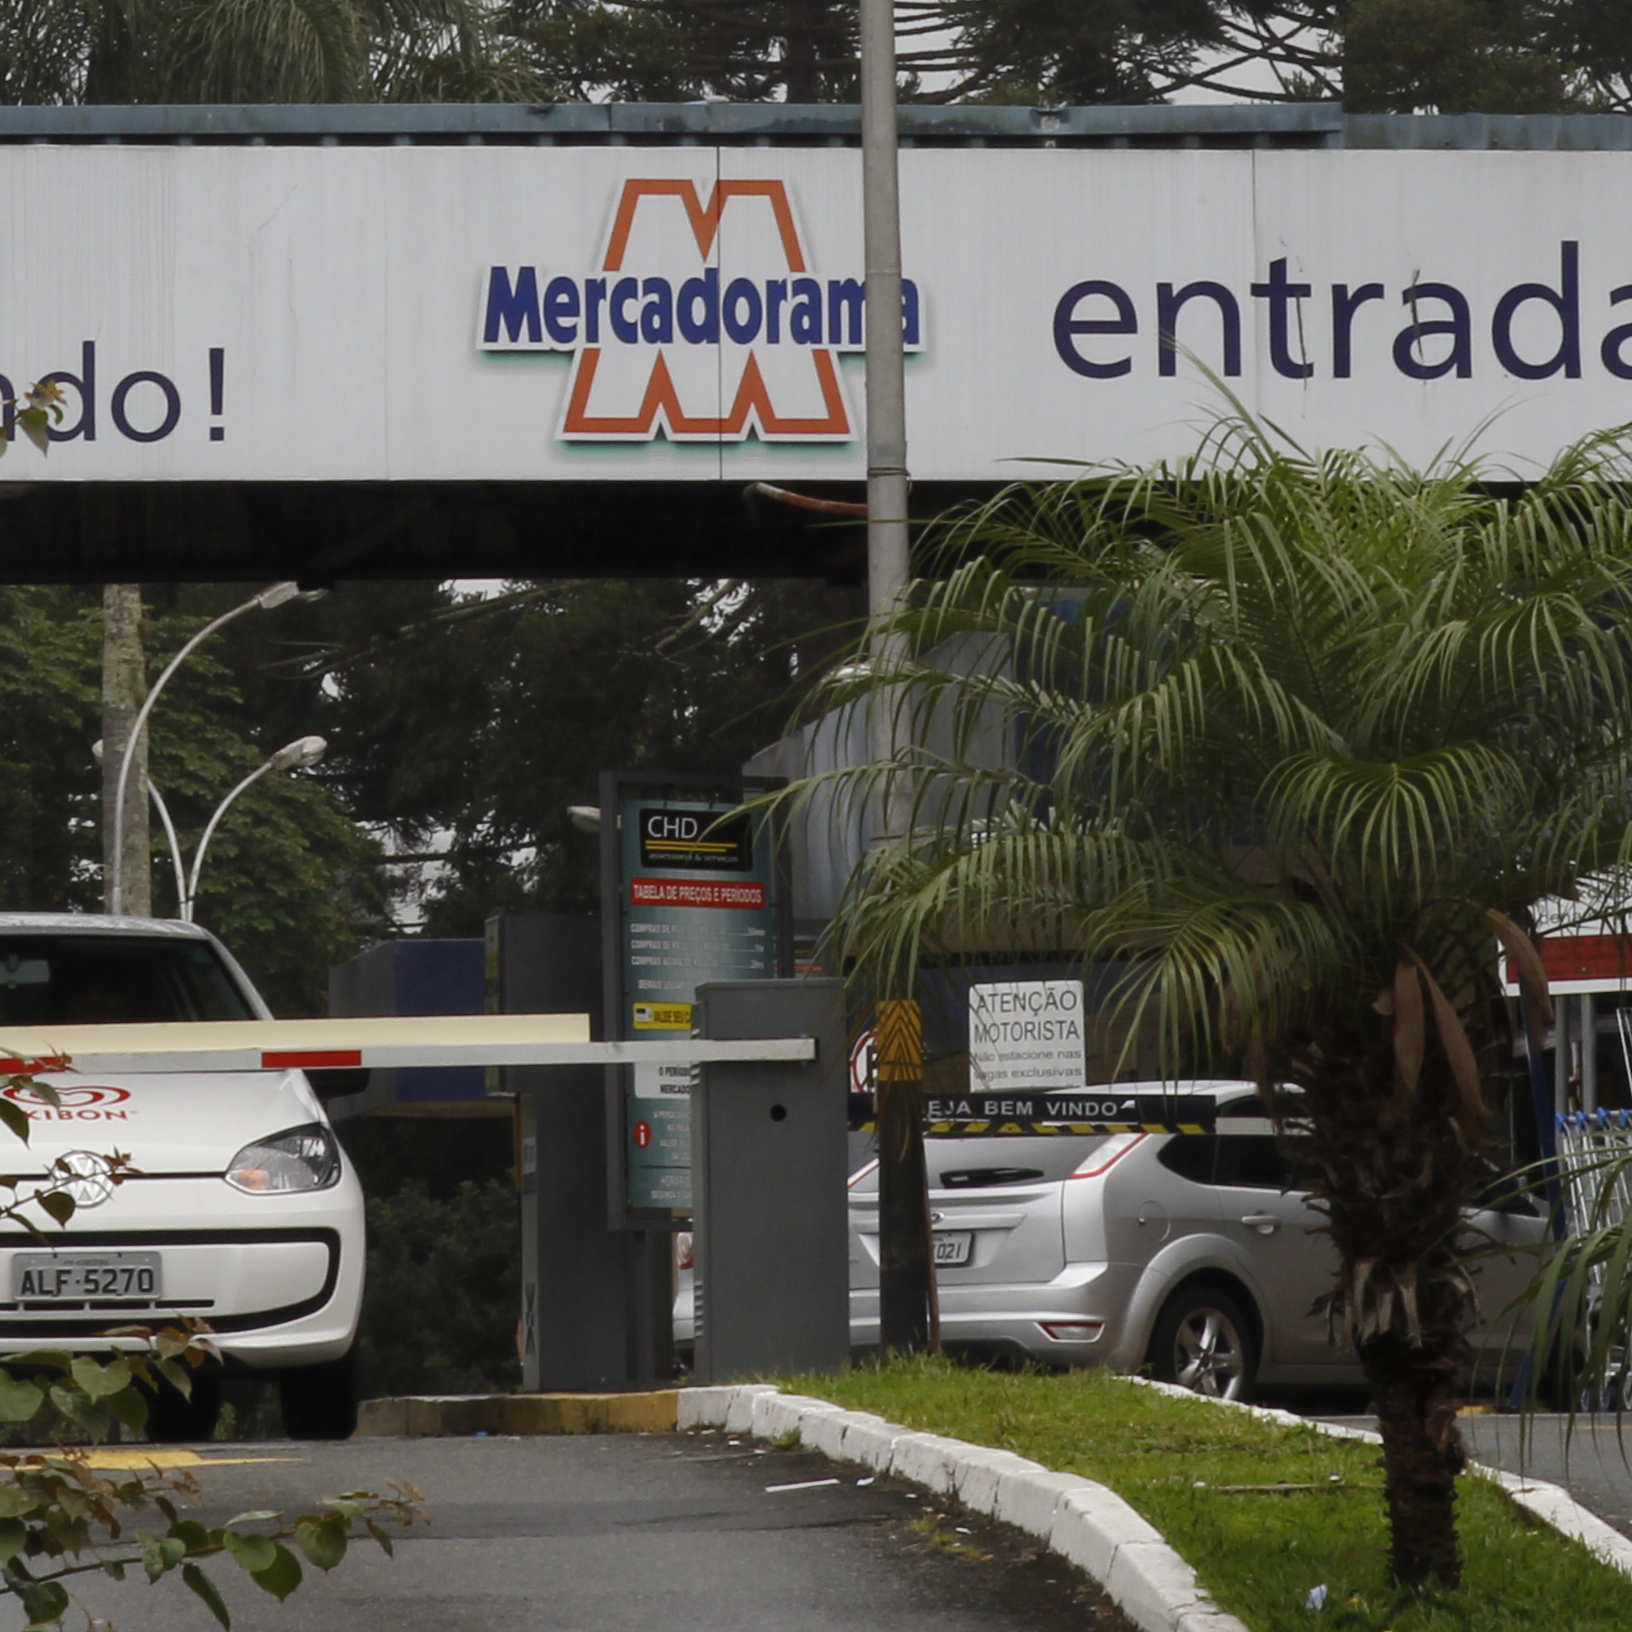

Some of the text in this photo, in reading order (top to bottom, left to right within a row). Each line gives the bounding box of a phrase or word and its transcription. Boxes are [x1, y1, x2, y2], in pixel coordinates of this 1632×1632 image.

[482, 266, 921, 345] Mercadorama
[647, 815, 698, 839] CHD
[633, 884, 762, 904] TABELA DE PREÇOS E PERÍODOS
[976, 987, 1078, 1016] ATENÇÃO
[974, 1019, 1080, 1044] MOTORISTA
[998, 1050, 1053, 1062] estacione
[1057, 1049, 1082, 1059] nas
[1011, 1067, 1082, 1078] exclusivas
[23, 1109, 128, 1121] KIBON
[927, 1100, 1118, 1116] EJA BEM VINDO
